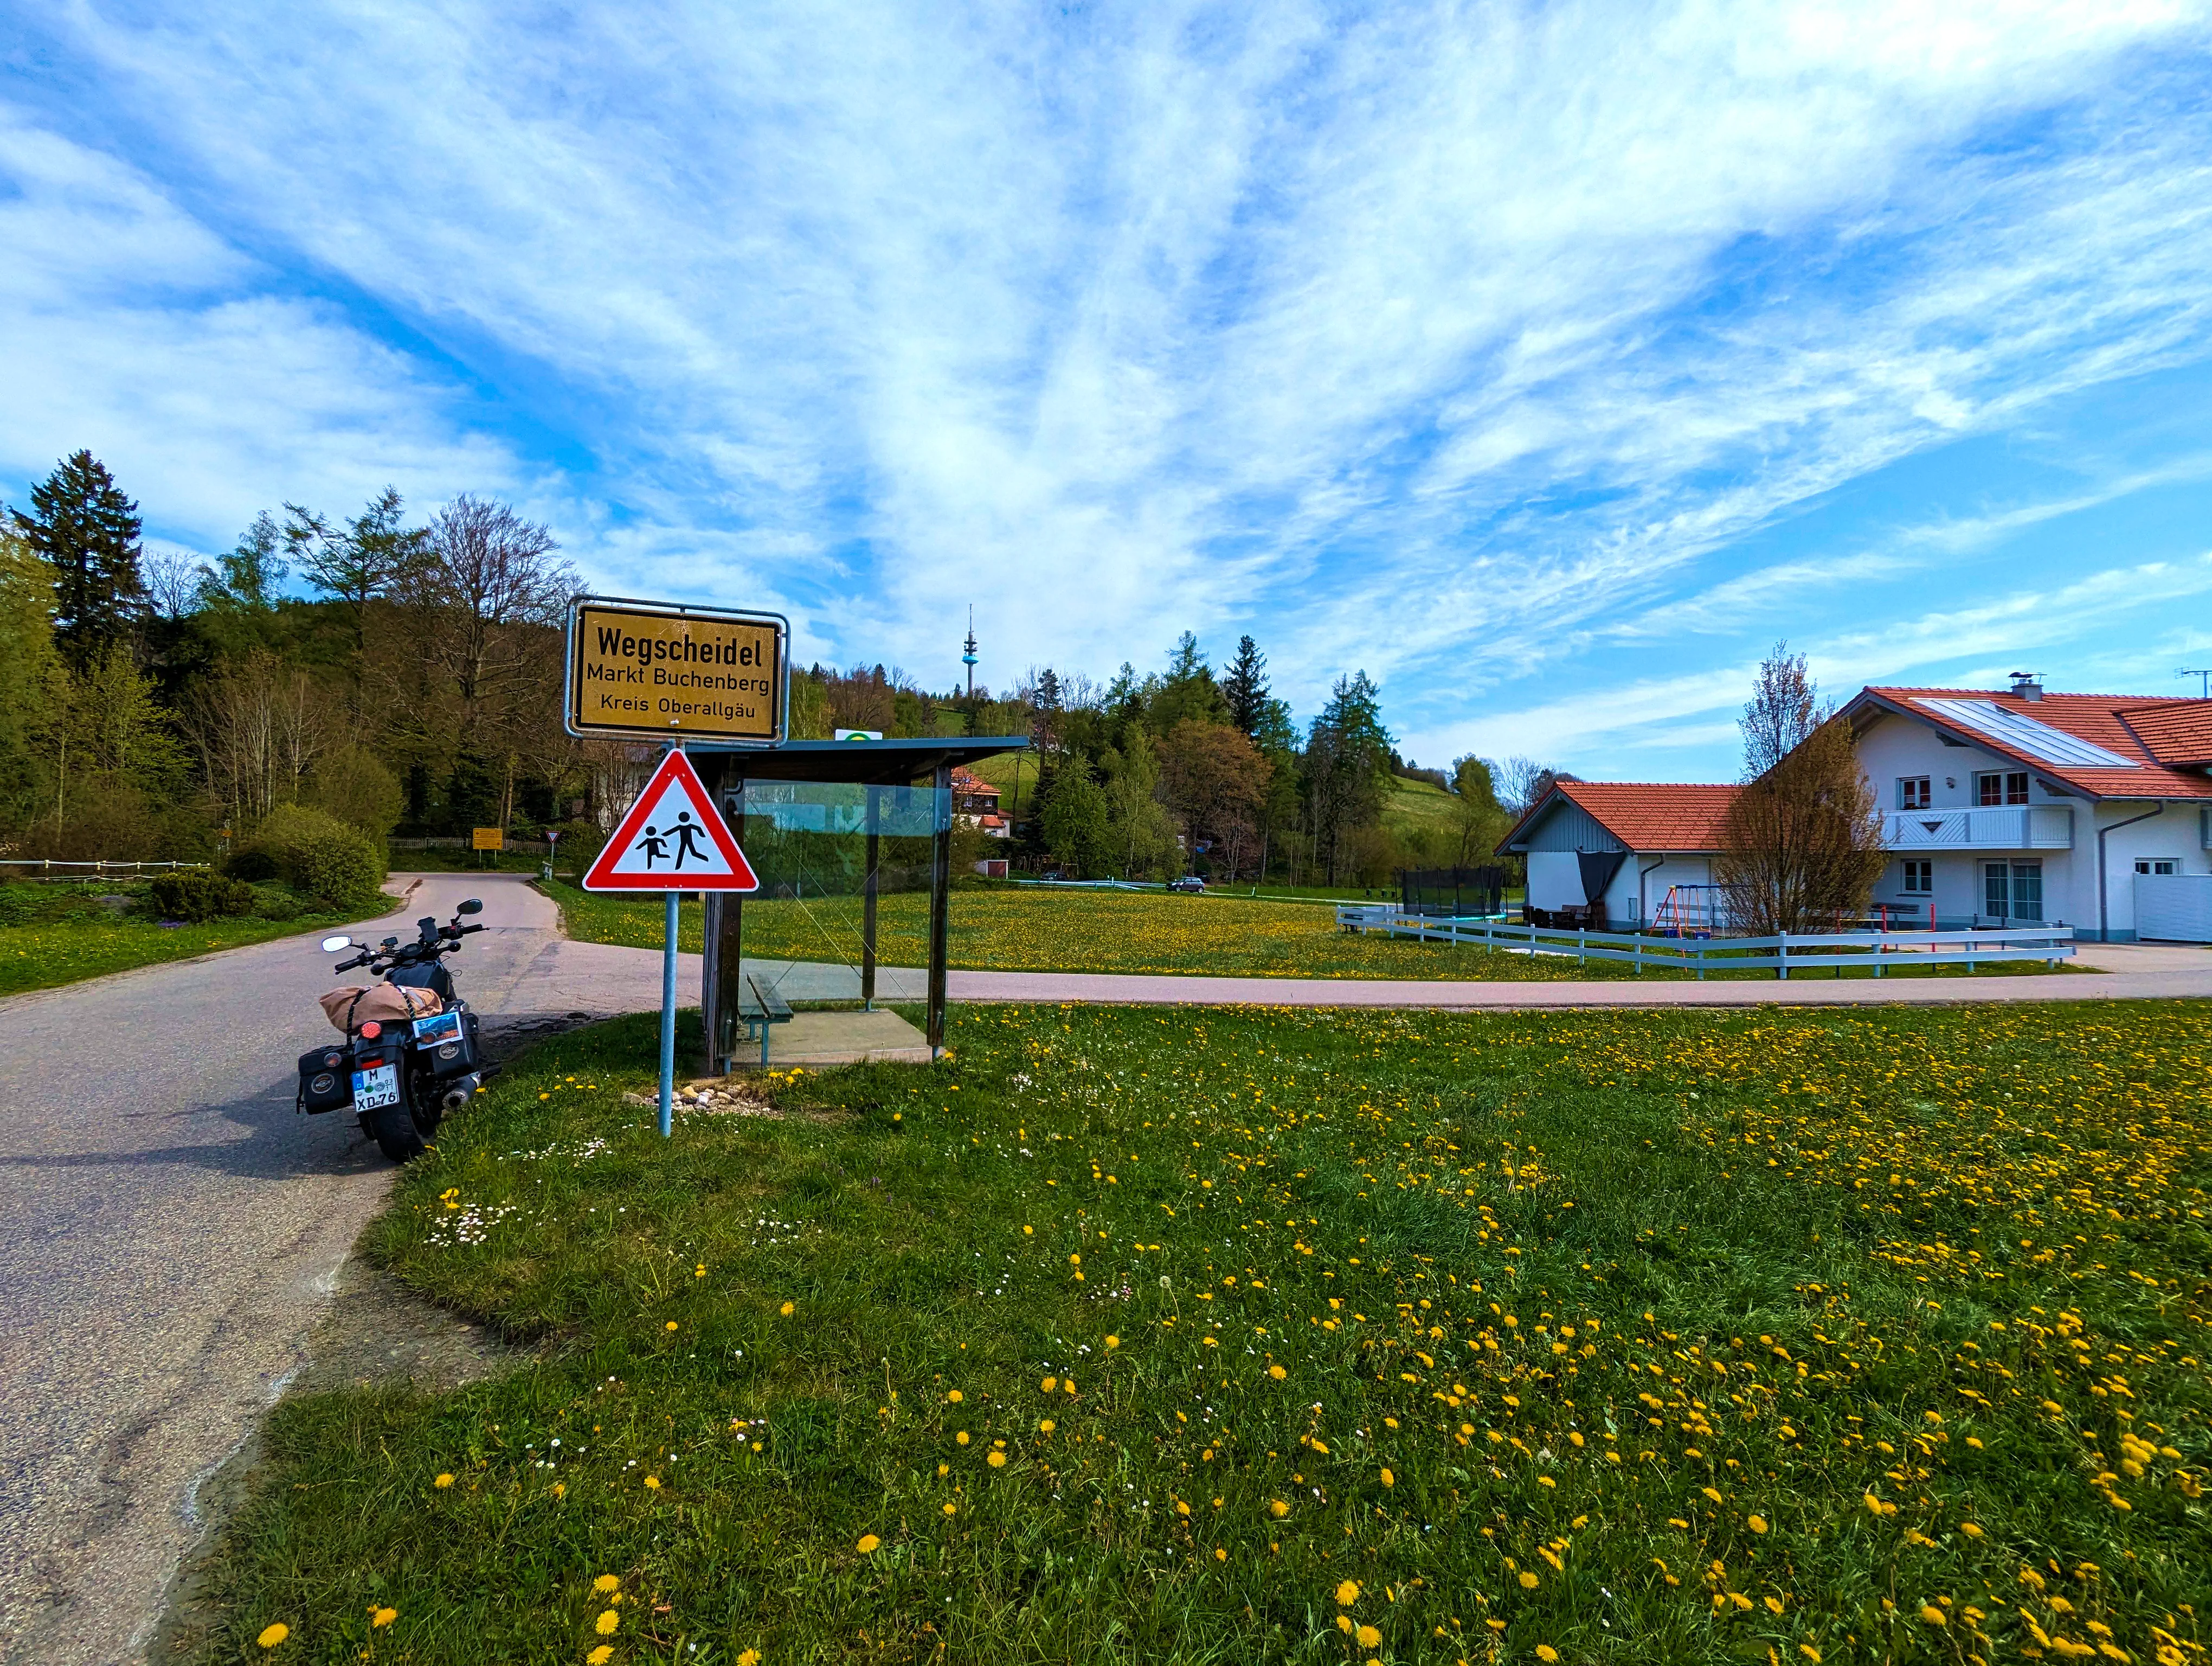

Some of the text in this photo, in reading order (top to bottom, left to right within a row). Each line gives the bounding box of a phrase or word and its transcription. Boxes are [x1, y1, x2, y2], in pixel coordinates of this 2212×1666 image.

[597, 627, 762, 667] Wegscheidel
[587, 663, 769, 696] Markt Buchenberg
[601, 694, 755, 720] Kreis Oberallgäu
[369, 1069, 378, 1081] M
[357, 1092, 396, 1111] XD 76
